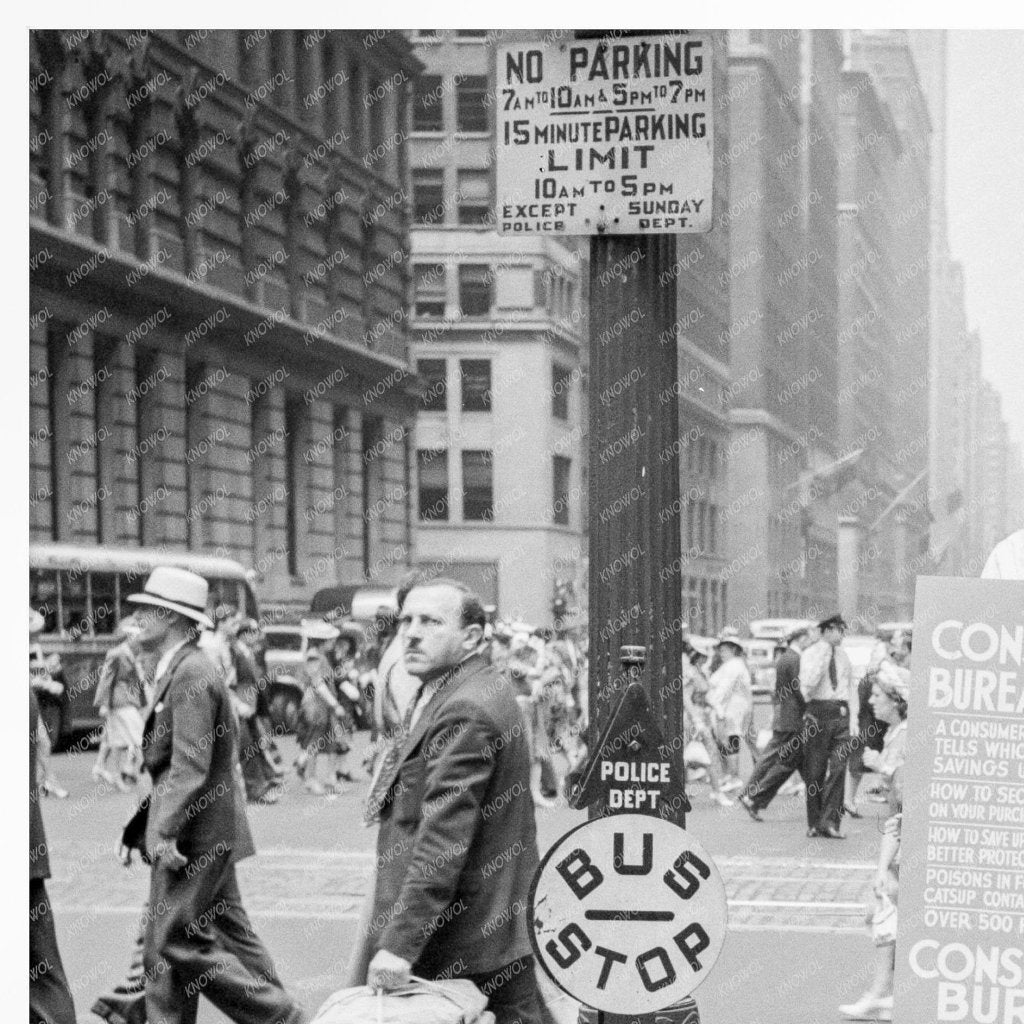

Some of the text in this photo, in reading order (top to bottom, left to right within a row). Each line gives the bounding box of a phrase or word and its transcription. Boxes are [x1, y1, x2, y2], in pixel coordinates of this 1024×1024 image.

[506, 41, 703, 84] NO PARKING
[536, 91, 548, 103] TO
[654, 85, 667, 98] TO
[504, 112, 706, 145] 15 MINUTE PARKING
[548, 145, 655, 172] LIMIT
[589, 179, 615, 193] TO
[502, 199, 705, 218] EXCEPT SUNDAY
[502, 221, 565, 232] POLICE
[936, 719, 947, 736] A
[934, 738, 978, 756] TELLS
[601, 761, 671, 783] POLICE
[933, 756, 1009, 777] SAVINGS
[609, 789, 660, 809] DEPT
[930, 782, 968, 801] HOW
[972, 785, 992, 802] TO
[929, 802, 948, 818] ON
[951, 803, 985, 820] YOUR
[928, 826, 961, 844] HOW
[964, 828, 979, 845] TO
[980, 829, 1009, 847] SAVE
[927, 845, 974, 863] BETTER
[555, 832, 711, 900] BUS
[926, 869, 992, 888] POISONS
[996, 874, 1011, 890] IN
[923, 887, 977, 905] CATSUP
[924, 910, 972, 930] OVER
[978, 914, 1013, 933] 500
[545, 922, 710, 992] STOP
